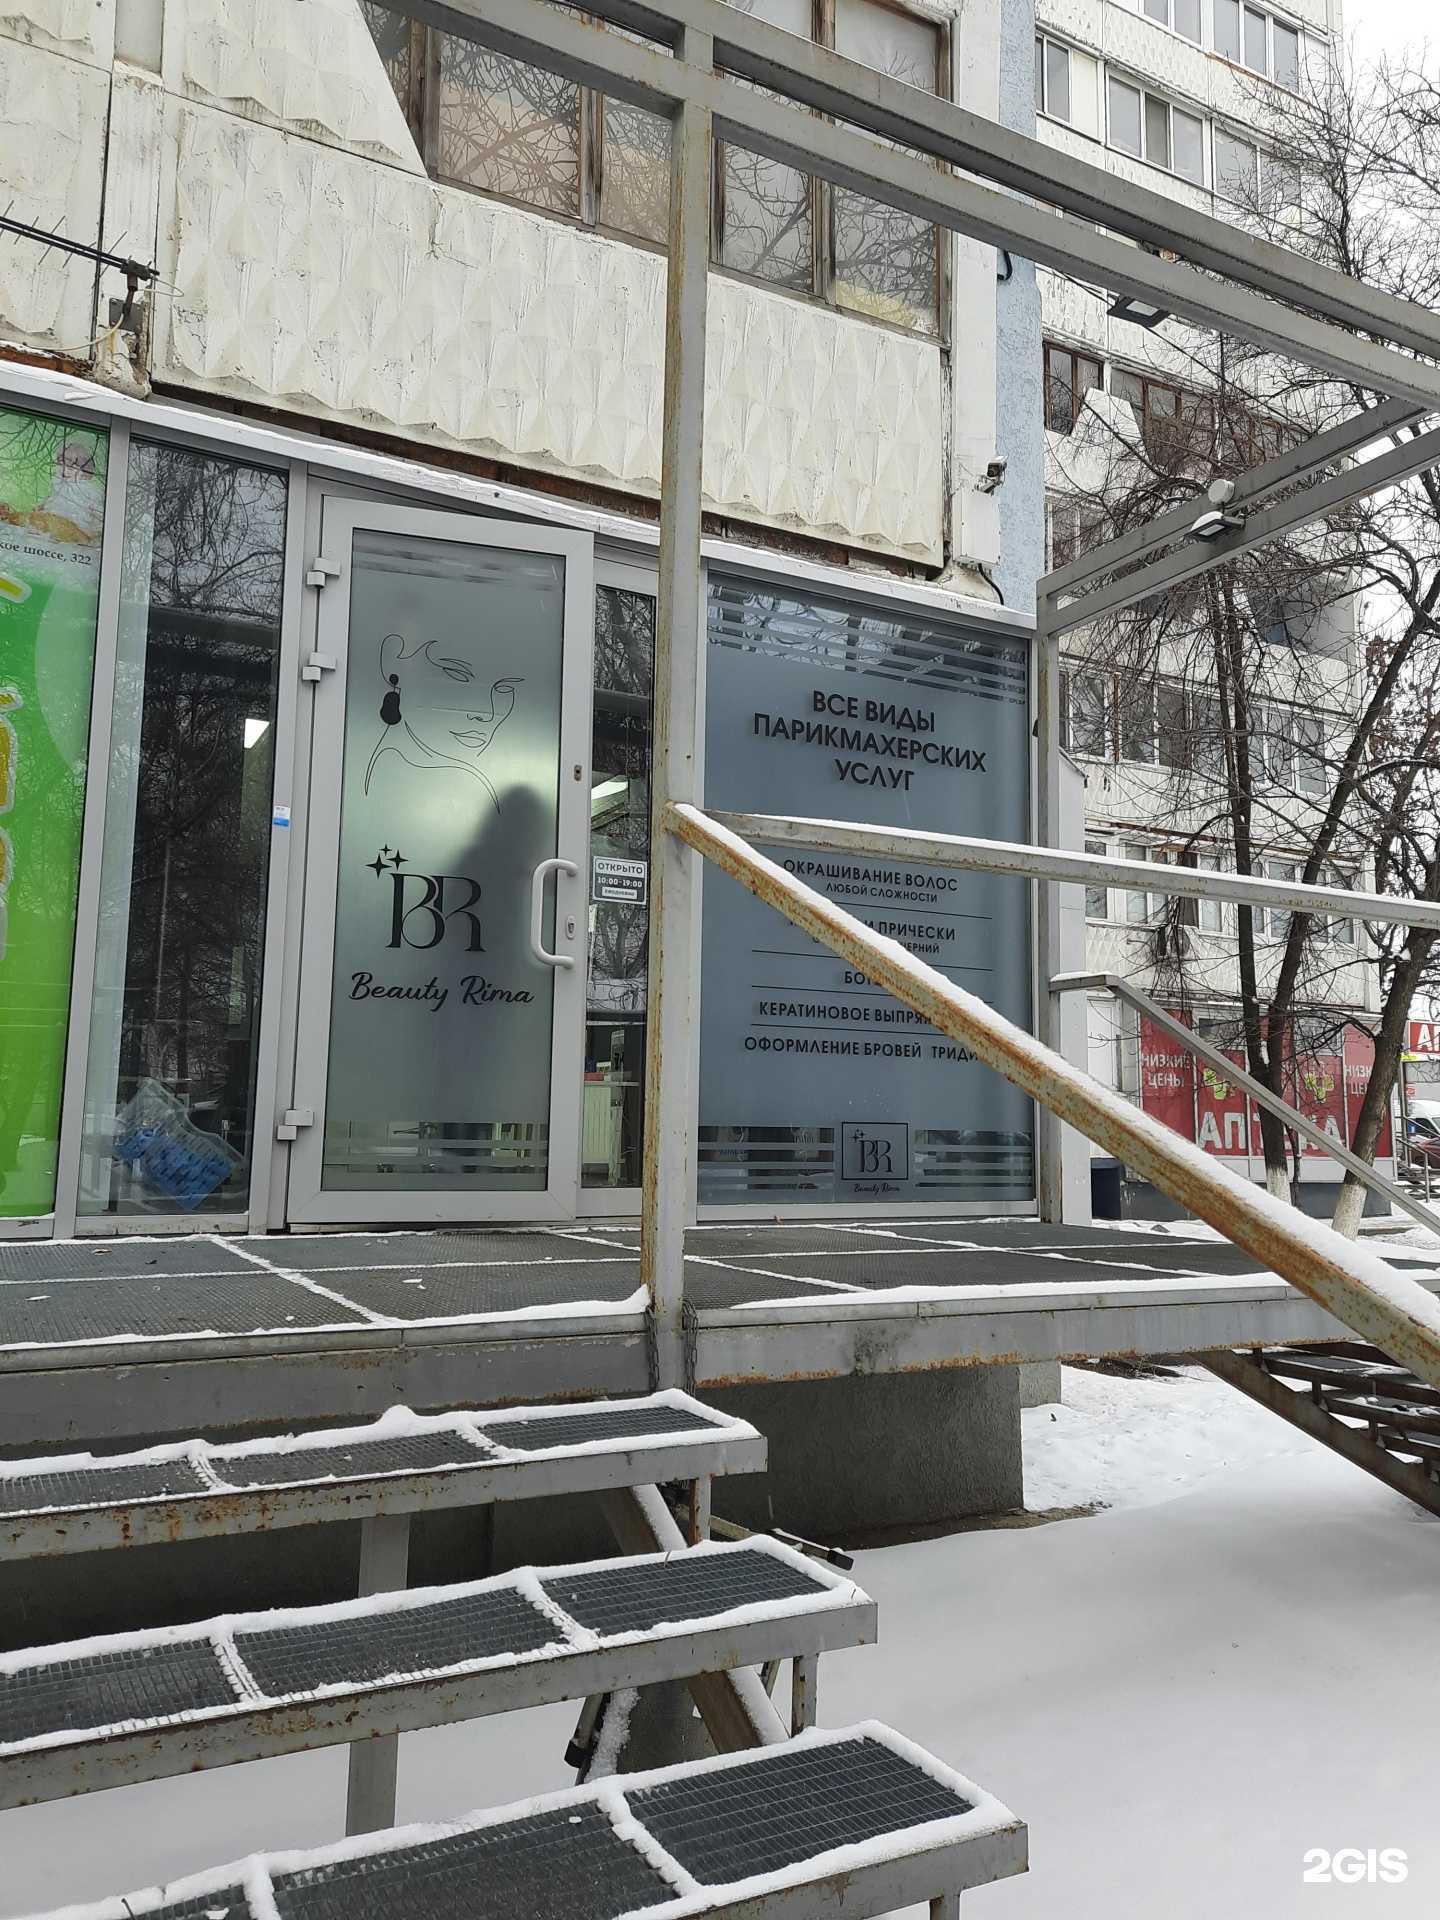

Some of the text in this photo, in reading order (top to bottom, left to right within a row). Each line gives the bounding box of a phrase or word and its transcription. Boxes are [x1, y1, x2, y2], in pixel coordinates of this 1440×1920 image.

[23, 546, 66, 562] шоссе,
[70, 553, 92, 565] 322
[813, 690, 936, 734] ВСЕ ВИДЫ
[753, 713, 987, 773] ПАРИКМАХЕРСКИХ
[834, 759, 915, 791] УСЛУГ
[598, 863, 643, 874] ОТКРЫТО
[783, 859, 958, 892] ОКРАШИВАНИЕ ВОЛОС
[826, 882, 938, 903] ЛЮБОЙ СЛОЖНОСТИ
[385, 872, 487, 953] BR
[879, 920, 955, 941] ПРИЧЕСКИ
[349, 971, 535, 1012] Beauty Rima
[759, 1001, 871, 1022] КЕРАТИНОВОЕ
[744, 1036, 860, 1056] ОФОРМЛЕНИЕ
[864, 1042, 922, 1059] БРОВЕЙ
